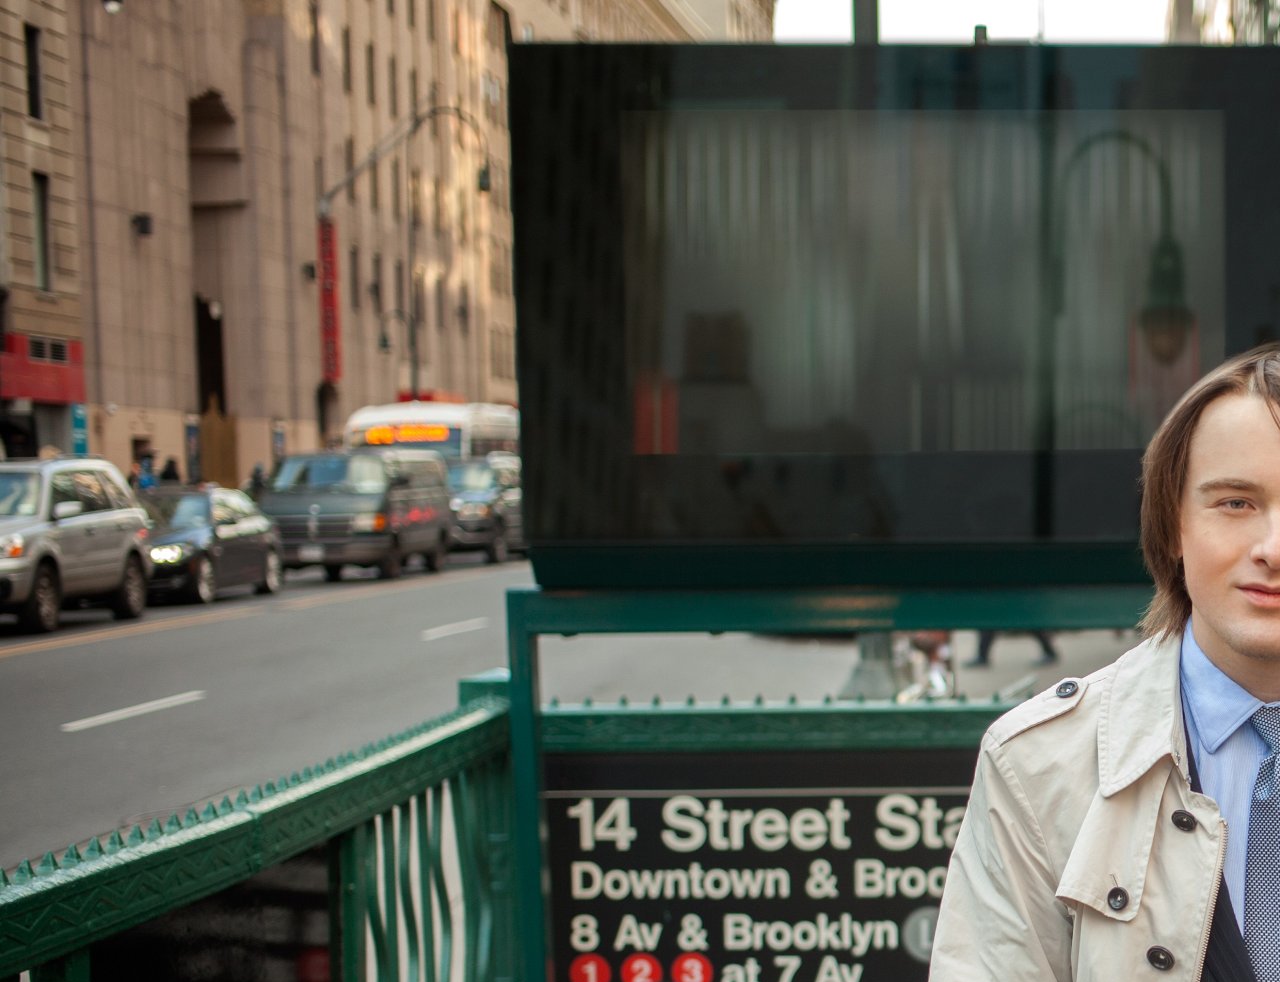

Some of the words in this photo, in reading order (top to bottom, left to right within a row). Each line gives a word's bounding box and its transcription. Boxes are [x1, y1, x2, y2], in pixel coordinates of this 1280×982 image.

[567, 797, 637, 851] 14
[661, 795, 852, 852] Street
[571, 862, 791, 899] Downtown
[806, 860, 839, 897] &
[571, 914, 600, 952] 8
[613, 914, 663, 951] Av
[678, 913, 709, 951] &
[724, 913, 899, 957] Brooklyn
